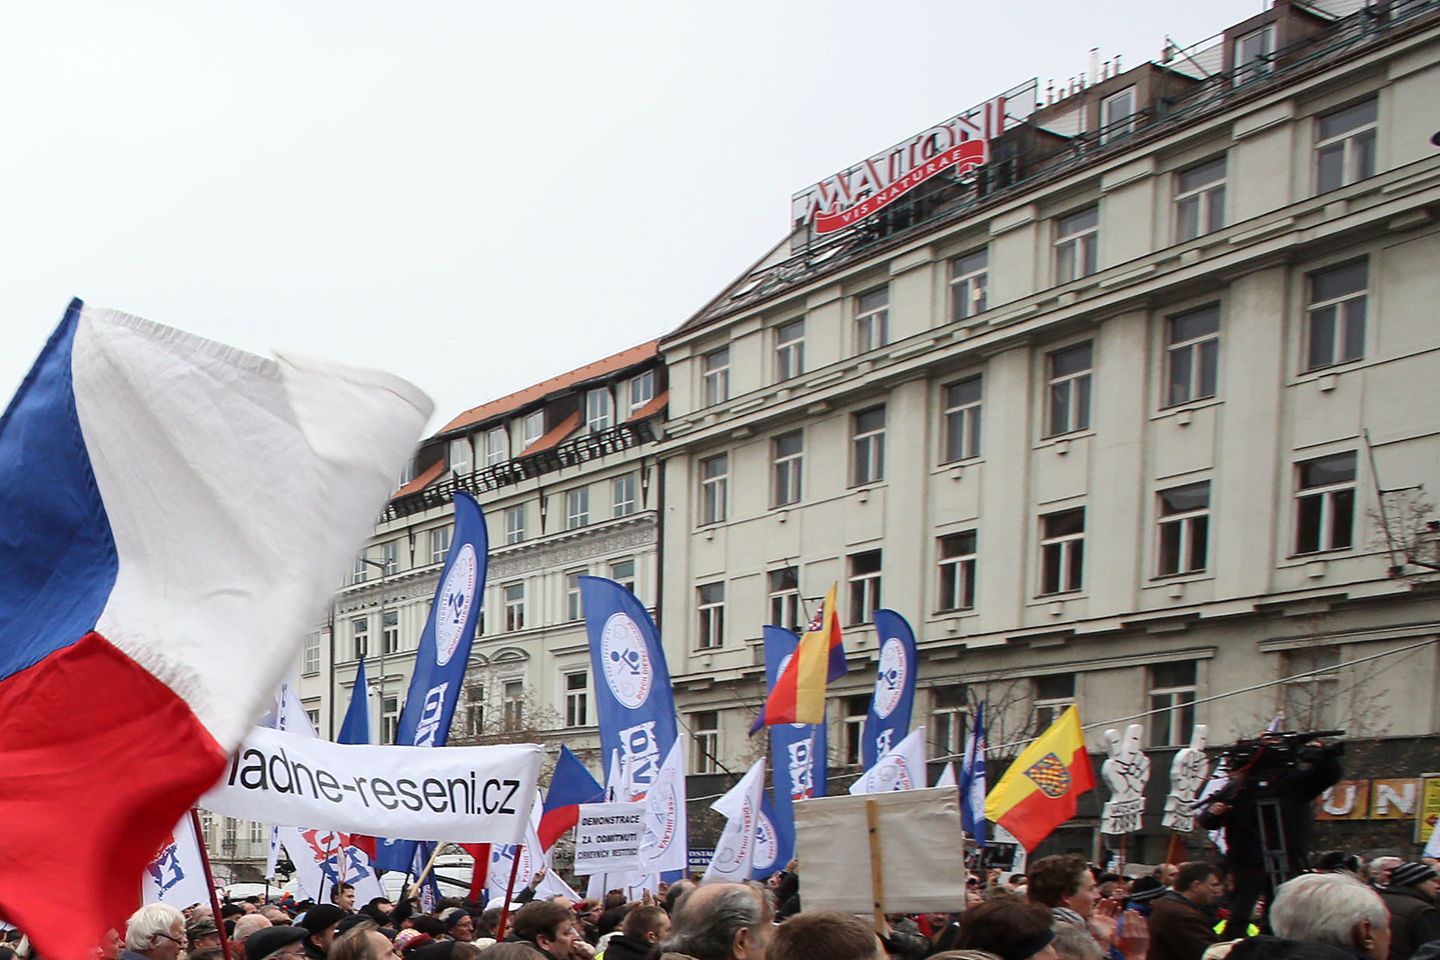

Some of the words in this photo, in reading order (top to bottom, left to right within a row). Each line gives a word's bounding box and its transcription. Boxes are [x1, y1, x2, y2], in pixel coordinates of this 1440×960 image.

[841, 204, 869, 223] VIS
[877, 148, 962, 205] NATURAE
[581, 814, 640, 826] DEMONSTRACE
[581, 835, 592, 845] ZA
